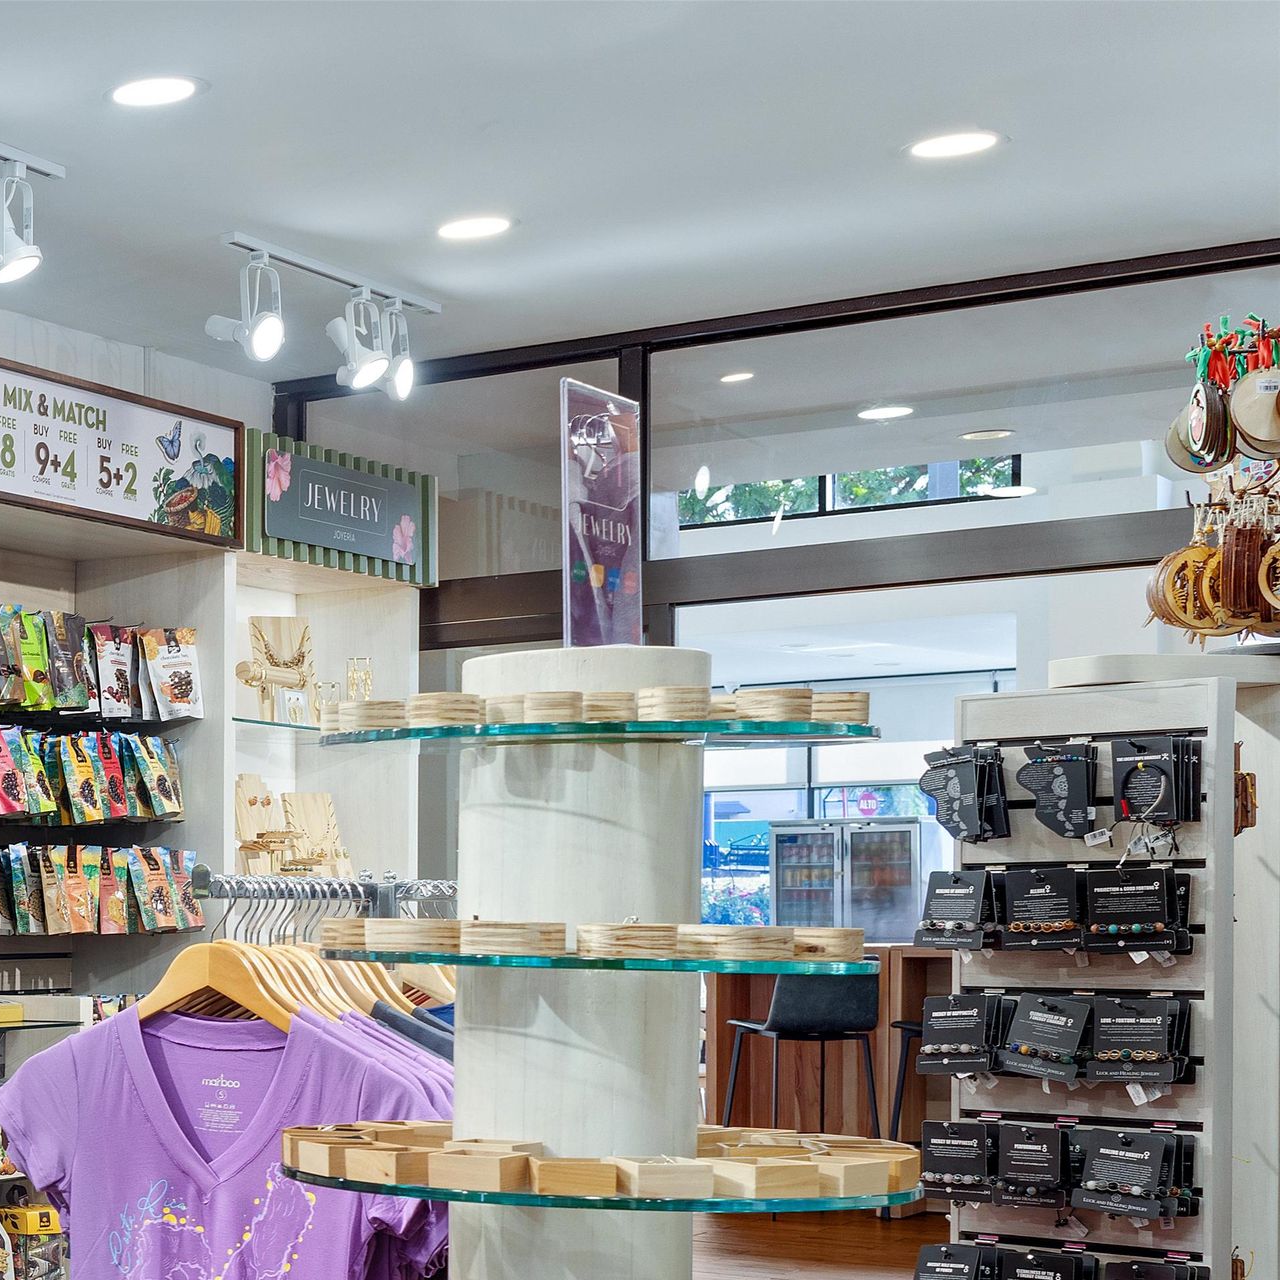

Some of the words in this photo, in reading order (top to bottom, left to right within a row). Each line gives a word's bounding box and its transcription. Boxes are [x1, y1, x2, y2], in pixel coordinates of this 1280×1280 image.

[3, 384, 34, 414] MIX
[37, 393, 49, 417] &
[52, 396, 107, 433] MATCH
[33, 423, 50, 438] BUY
[59, 430, 78, 445] FREE
[97, 437, 113, 451] BUY
[35, 441, 78, 483] 9+4
[121, 443, 139, 457] FREE
[99, 455, 137, 496] 5+2
[304, 483, 383, 522] JEWELRY
